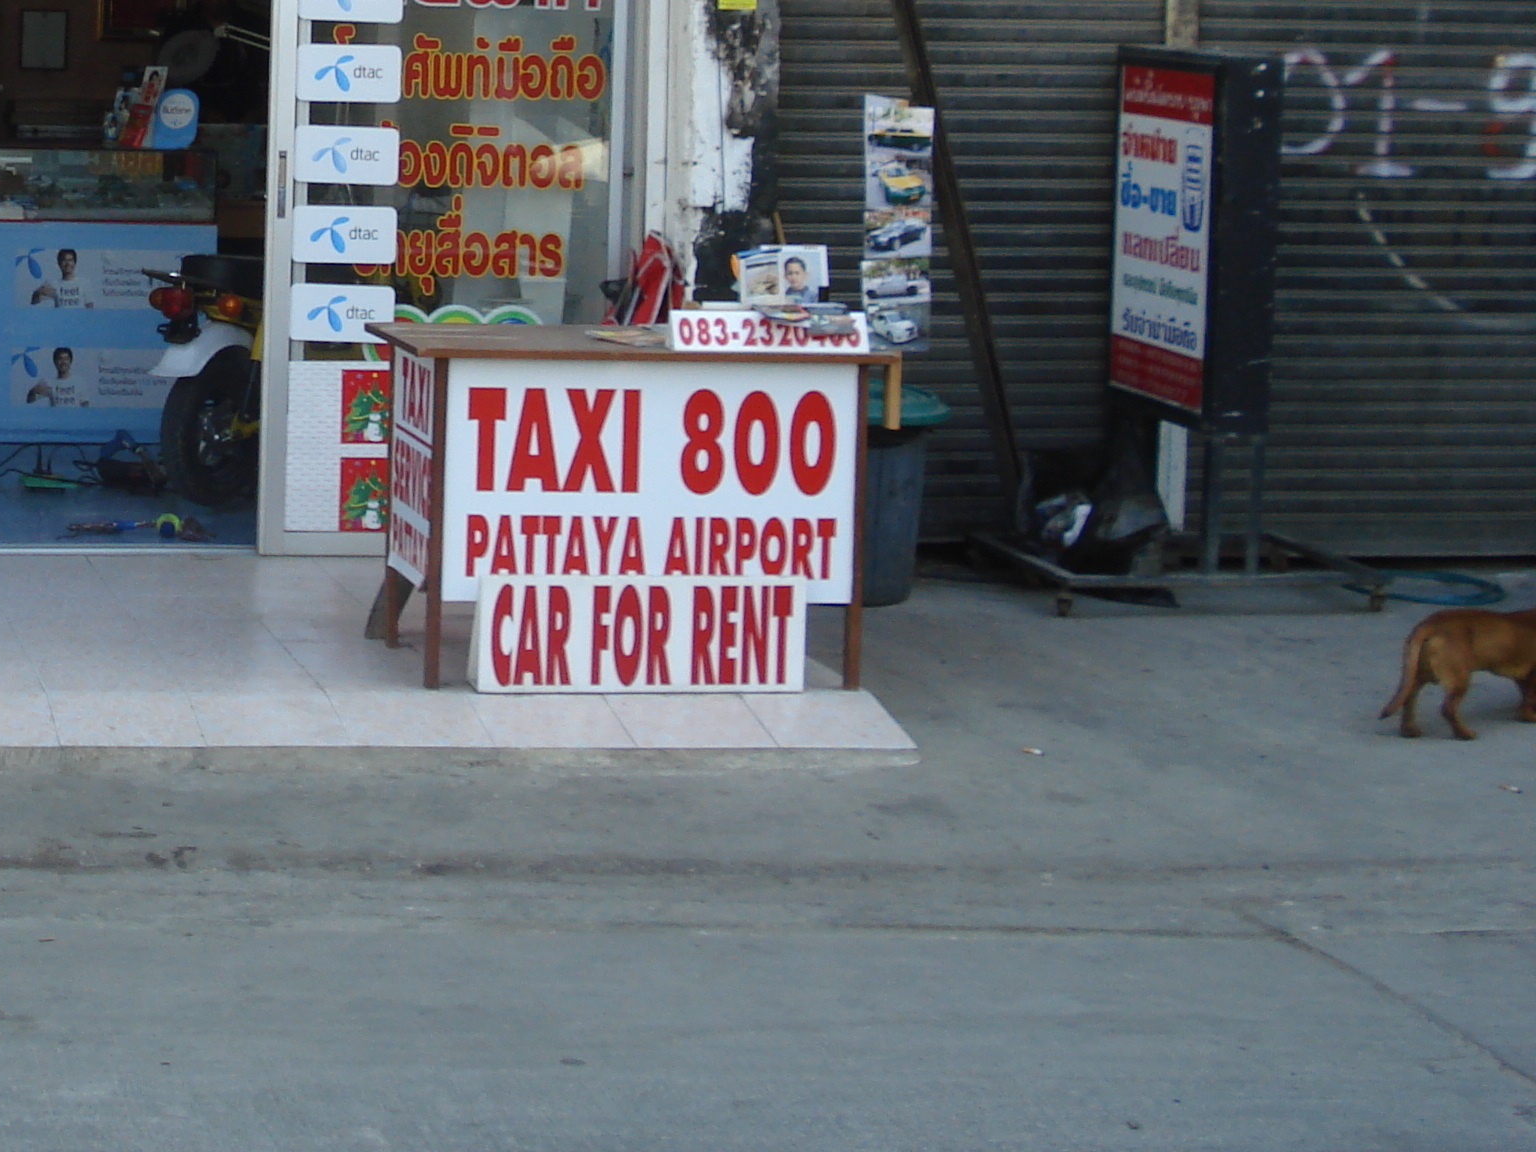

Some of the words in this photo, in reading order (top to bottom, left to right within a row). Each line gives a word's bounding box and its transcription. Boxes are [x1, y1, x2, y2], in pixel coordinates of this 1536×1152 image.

[353, 63, 383, 80] dtac
[350, 146, 380, 162] dtac
[348, 226, 379, 241] dtac
[345, 304, 376, 321] dtac
[468, 387, 641, 494] TAXI
[680, 388, 836, 496] 800
[466, 514, 644, 578] PATTAYA
[665, 516, 837, 580] AIRPORT
[491, 583, 572, 687] CAR
[591, 584, 670, 687] FOR
[690, 584, 795, 687] RENT
